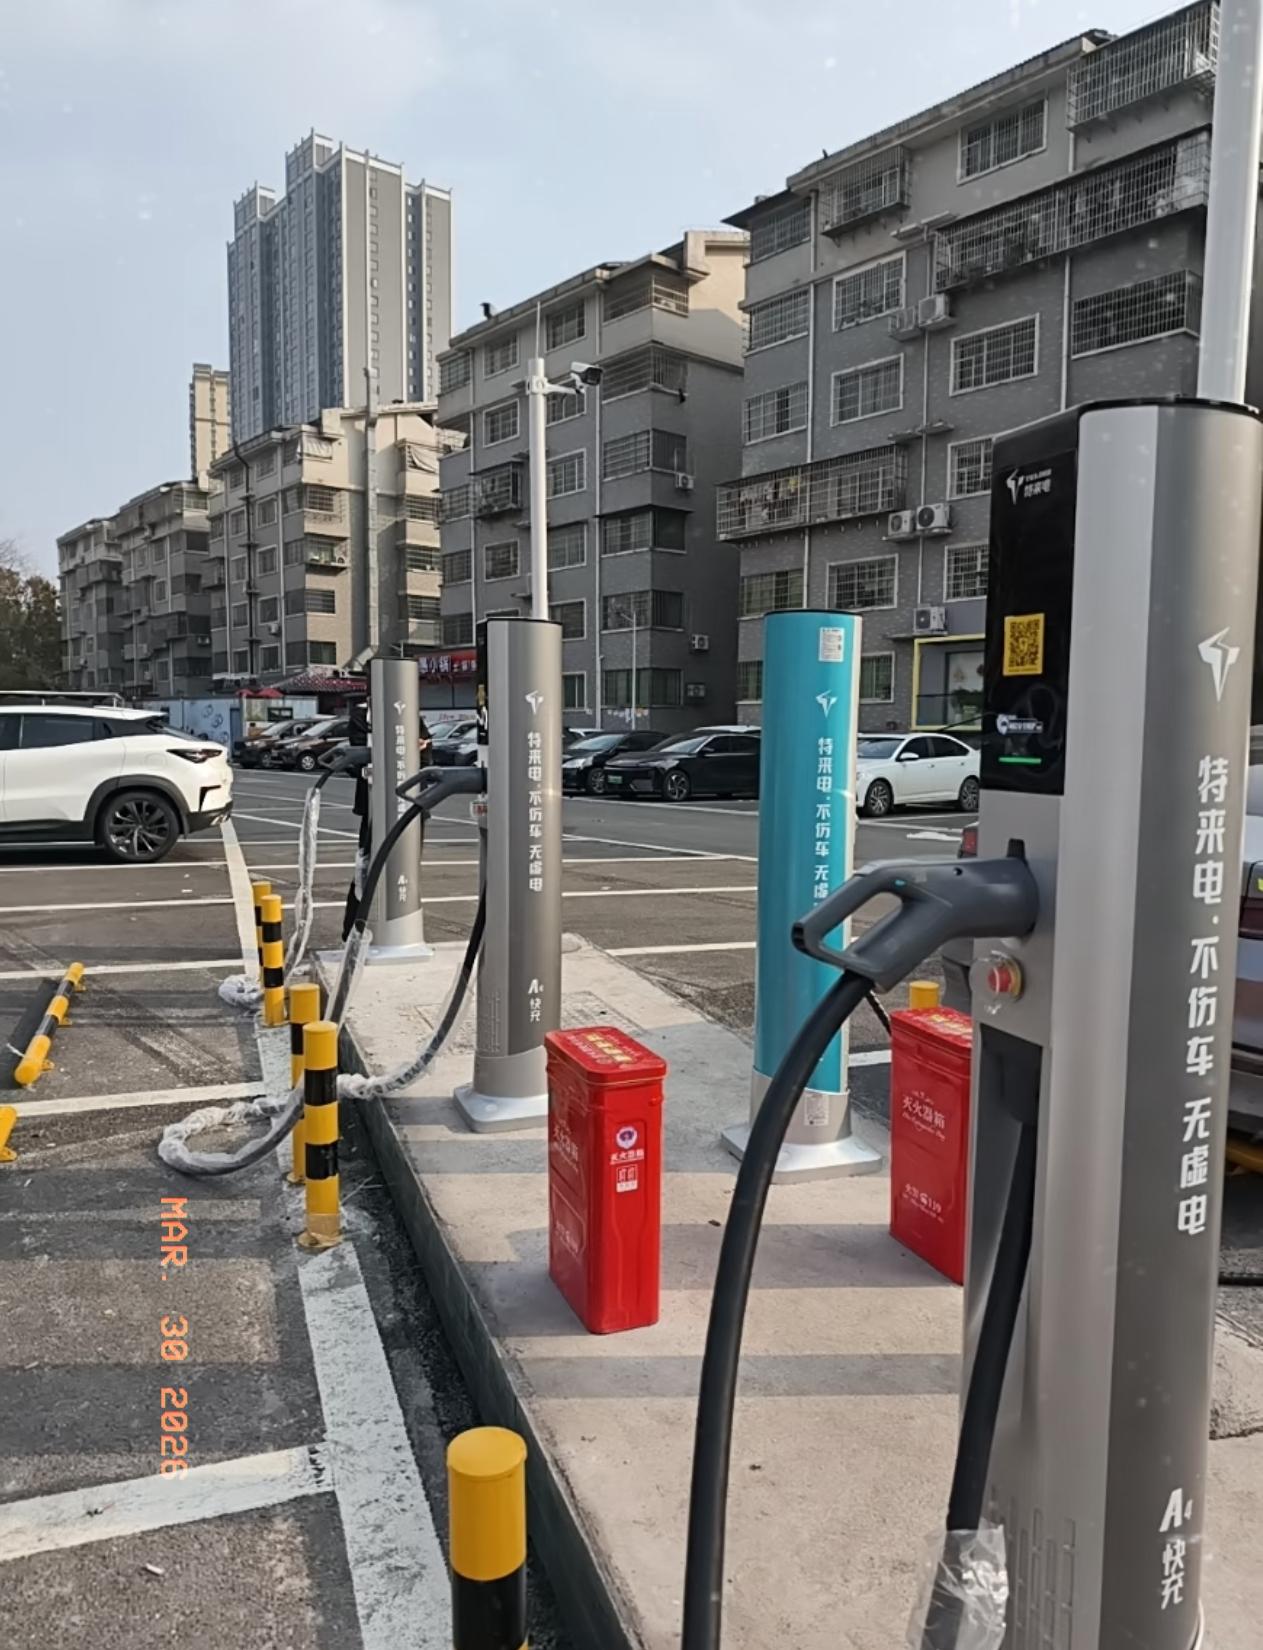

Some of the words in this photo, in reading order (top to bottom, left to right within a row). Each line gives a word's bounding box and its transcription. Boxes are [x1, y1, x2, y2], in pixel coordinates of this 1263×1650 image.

[814, 865, 829, 907] 无虚
[903, 1094, 945, 1129] 灭火器箱
[1177, 1097, 1212, 1236] 无虚电
[1161, 1539, 1187, 1611] 快充
